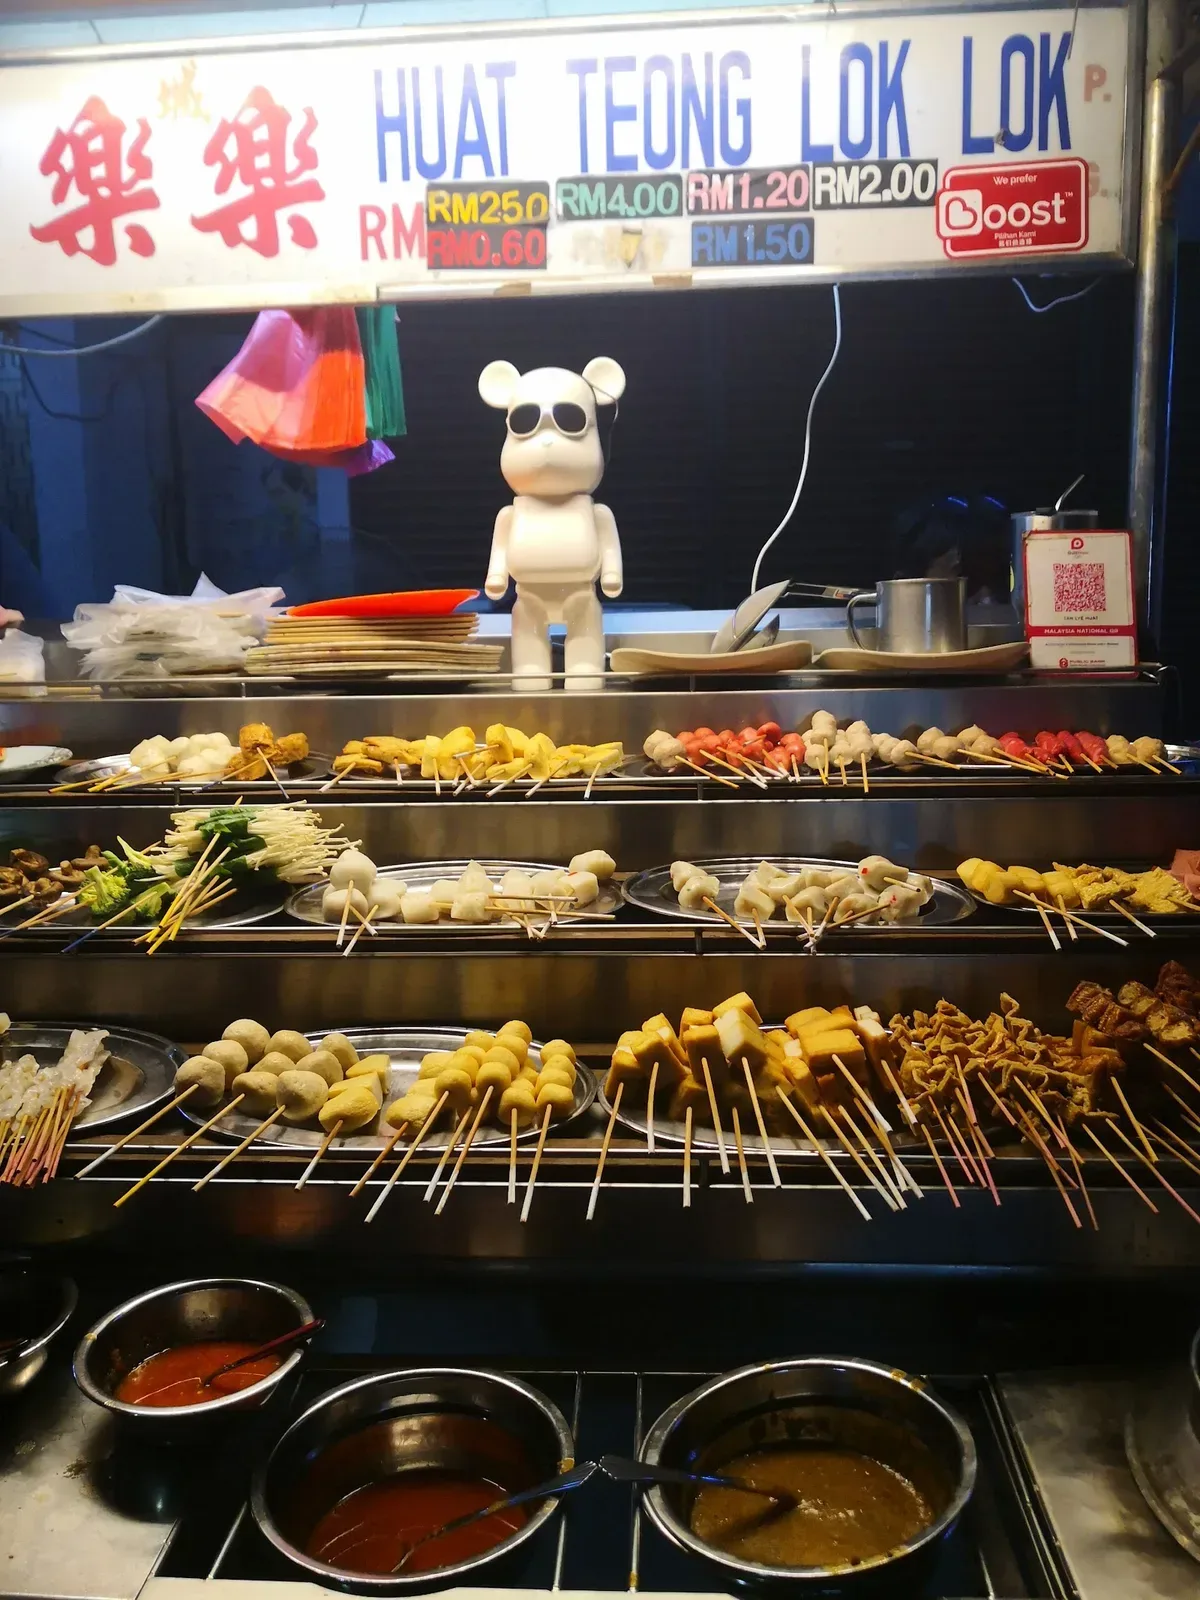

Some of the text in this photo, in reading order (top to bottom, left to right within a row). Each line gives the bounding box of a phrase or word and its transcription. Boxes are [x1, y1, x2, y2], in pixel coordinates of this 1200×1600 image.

[373, 32, 1072, 182] HUAT TEONG LOK LOK
[31, 86, 325, 266] 樂 樂
[688, 170, 809, 211] RM1.20
[814, 163, 935, 204] RM2.00
[993, 174, 1037, 186] We prefer
[557, 181, 679, 216] RM4.00
[428, 228, 545, 267] RM0.60
